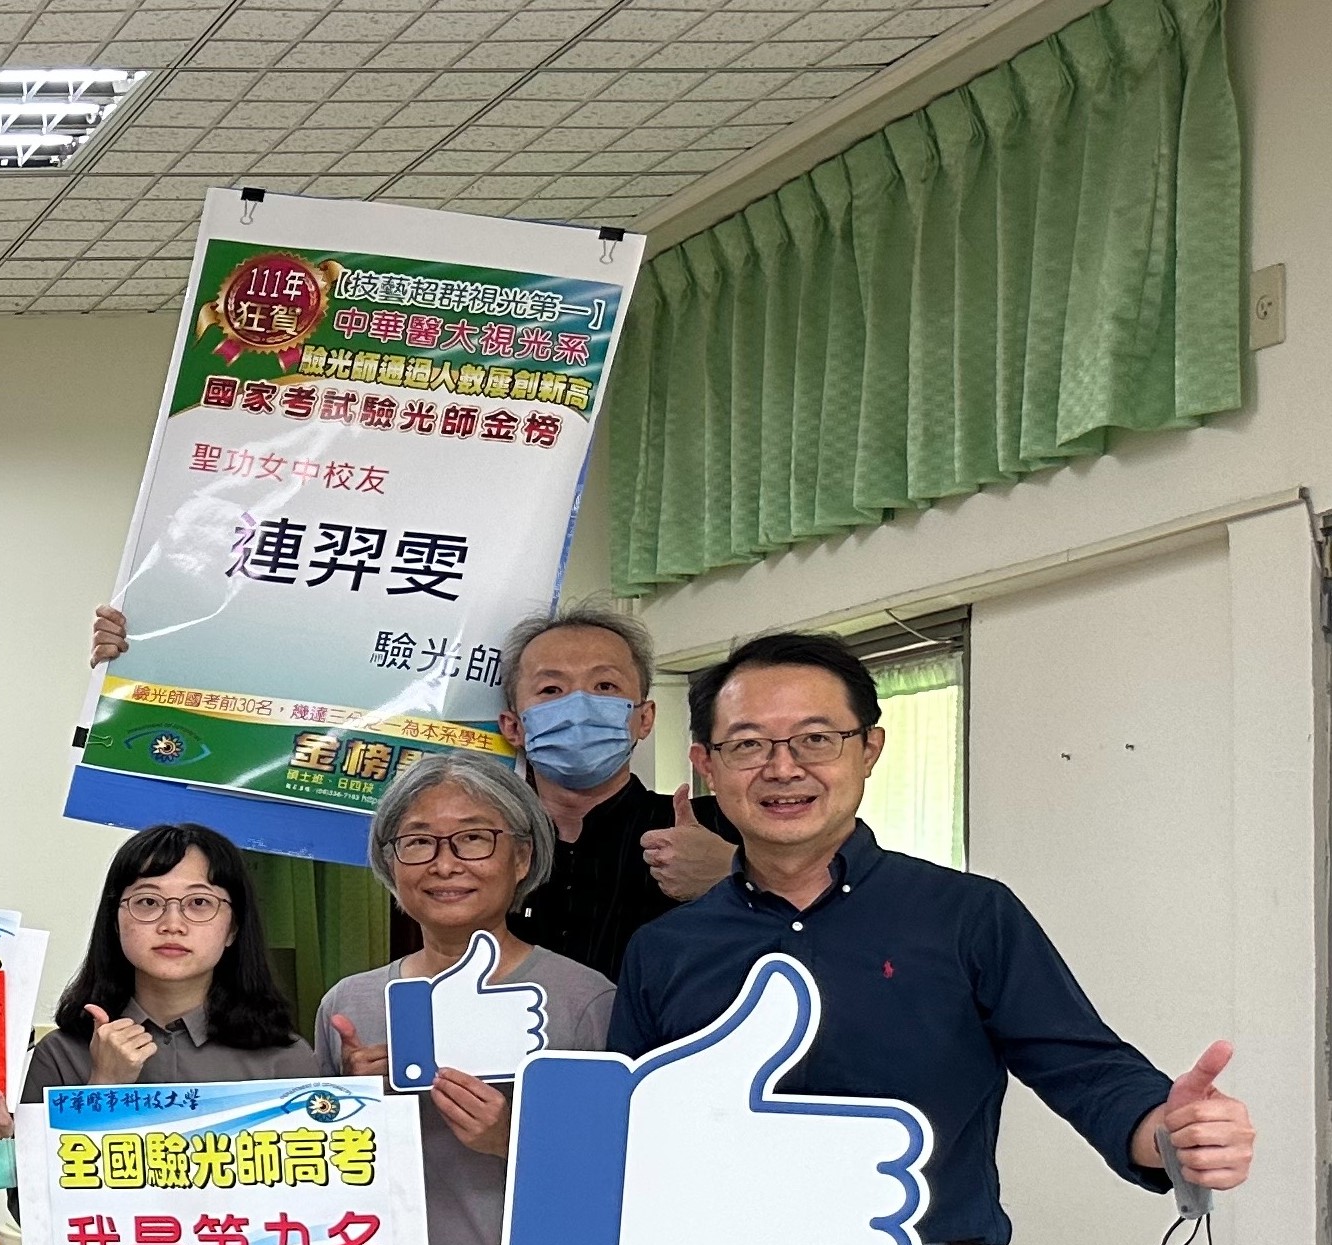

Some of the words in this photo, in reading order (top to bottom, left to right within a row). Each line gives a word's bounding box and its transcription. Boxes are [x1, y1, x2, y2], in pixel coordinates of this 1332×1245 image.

[247, 267, 305, 303] 111年
[234, 301, 302, 336] 狂賀
[333, 307, 592, 367] 中華醫大視光系
[297, 344, 593, 410] 驗光師通過人數屢創新高
[202, 376, 564, 448] 國家考試驗光師金榜
[188, 443, 390, 495] 聖功女中校友
[225, 513, 469, 602] 連羿雯
[369, 630, 504, 689] 驗光師
[52, 1088, 201, 1115] 中華醫事科技大學
[58, 1126, 376, 1189] 全國驗光師高考
